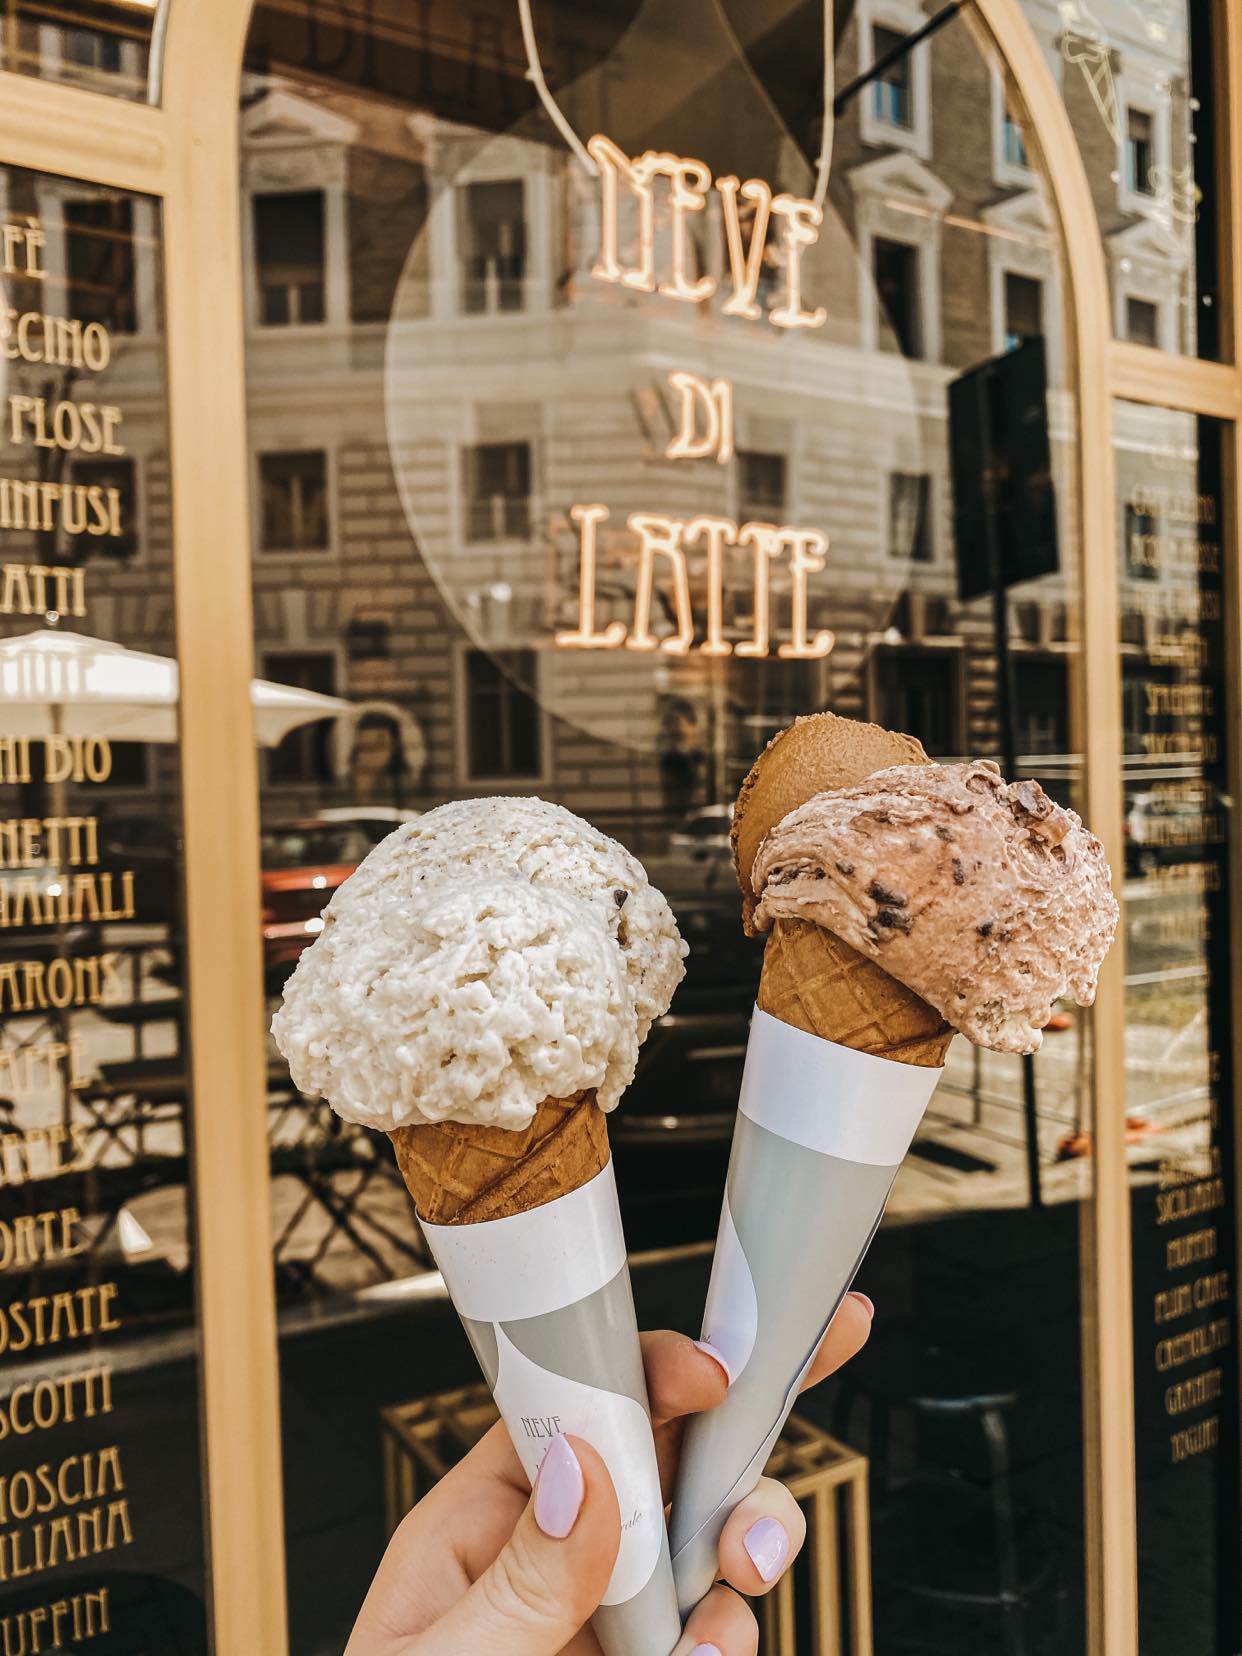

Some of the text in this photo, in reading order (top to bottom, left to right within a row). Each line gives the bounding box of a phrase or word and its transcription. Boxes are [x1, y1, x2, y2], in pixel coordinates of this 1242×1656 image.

[587, 134, 827, 328] NEVE
[666, 371, 733, 464] DI
[554, 503, 835, 659] LATTE
[44, 733, 112, 784] BIO
